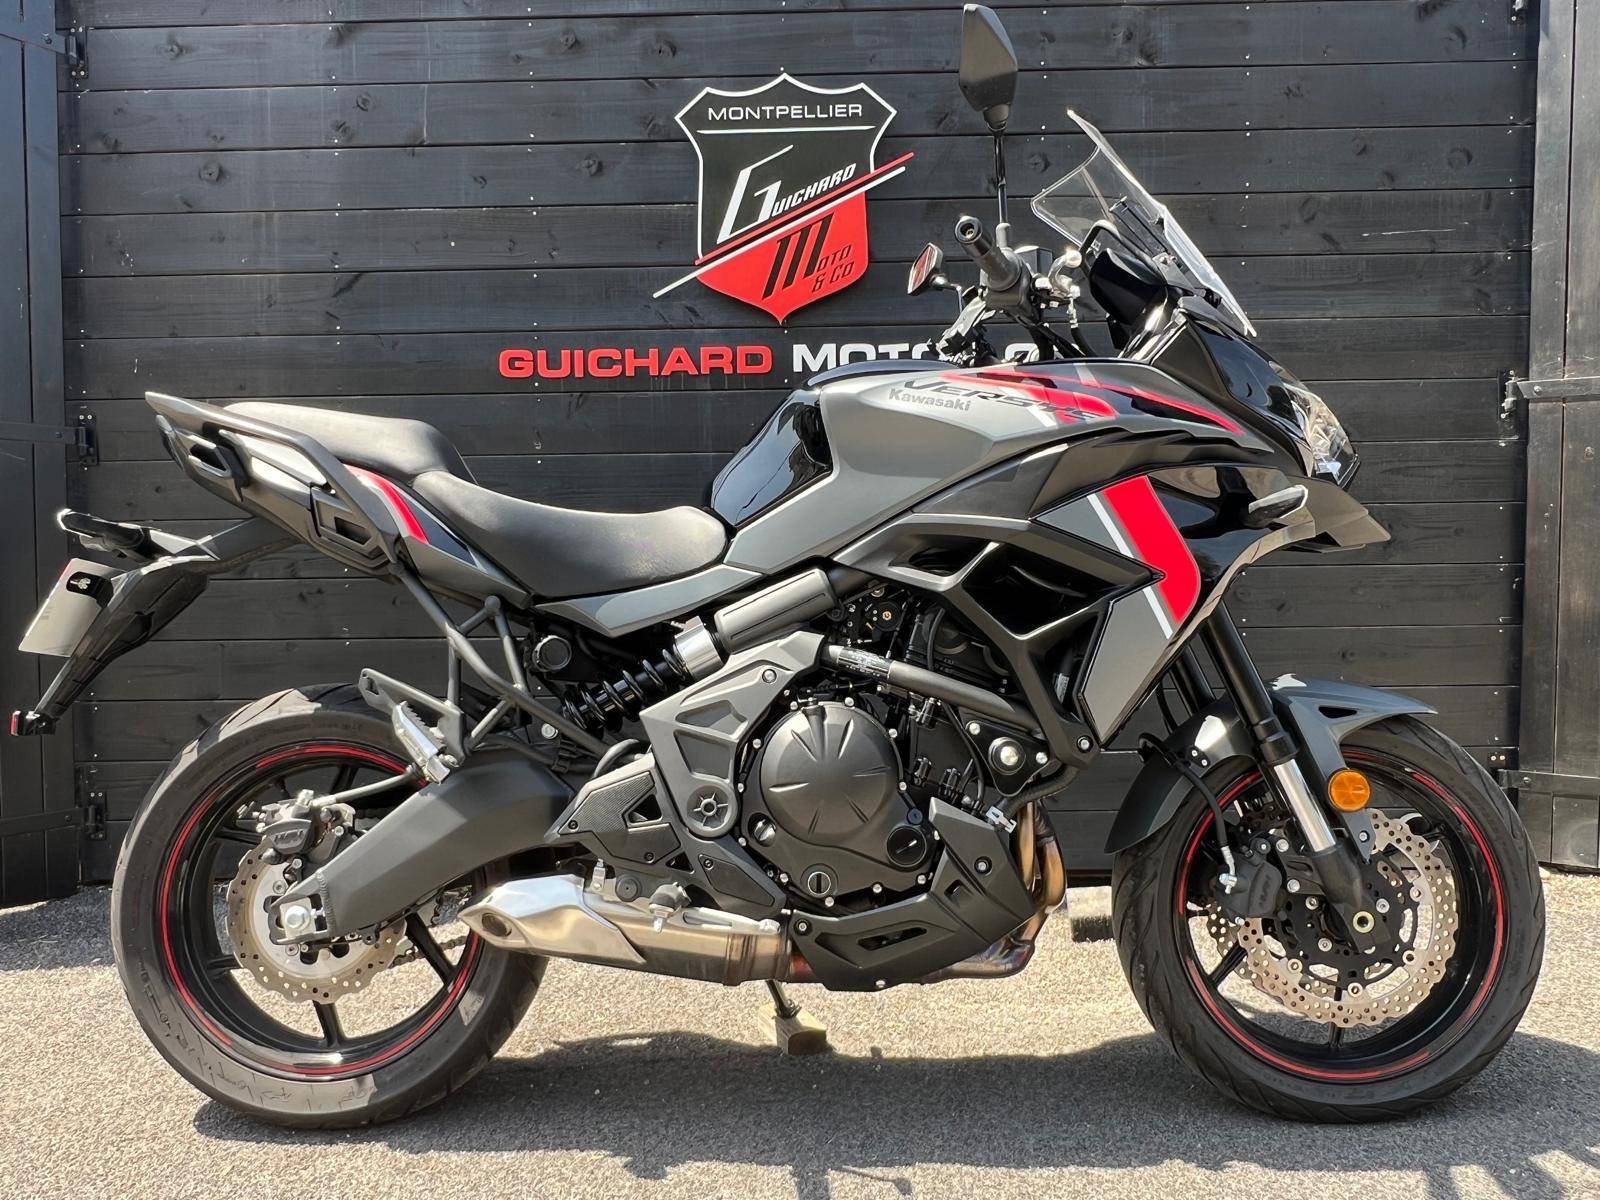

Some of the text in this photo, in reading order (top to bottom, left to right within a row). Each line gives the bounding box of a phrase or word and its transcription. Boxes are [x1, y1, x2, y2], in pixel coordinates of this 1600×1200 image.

[707, 103, 862, 121] MONTPELLIER
[716, 144, 856, 245] GUICHARD
[762, 213, 852, 300] MOTO
[829, 261, 855, 283] CO
[499, 343, 942, 379] GUICHARD MOT
[888, 387, 972, 412] Kawasaki
